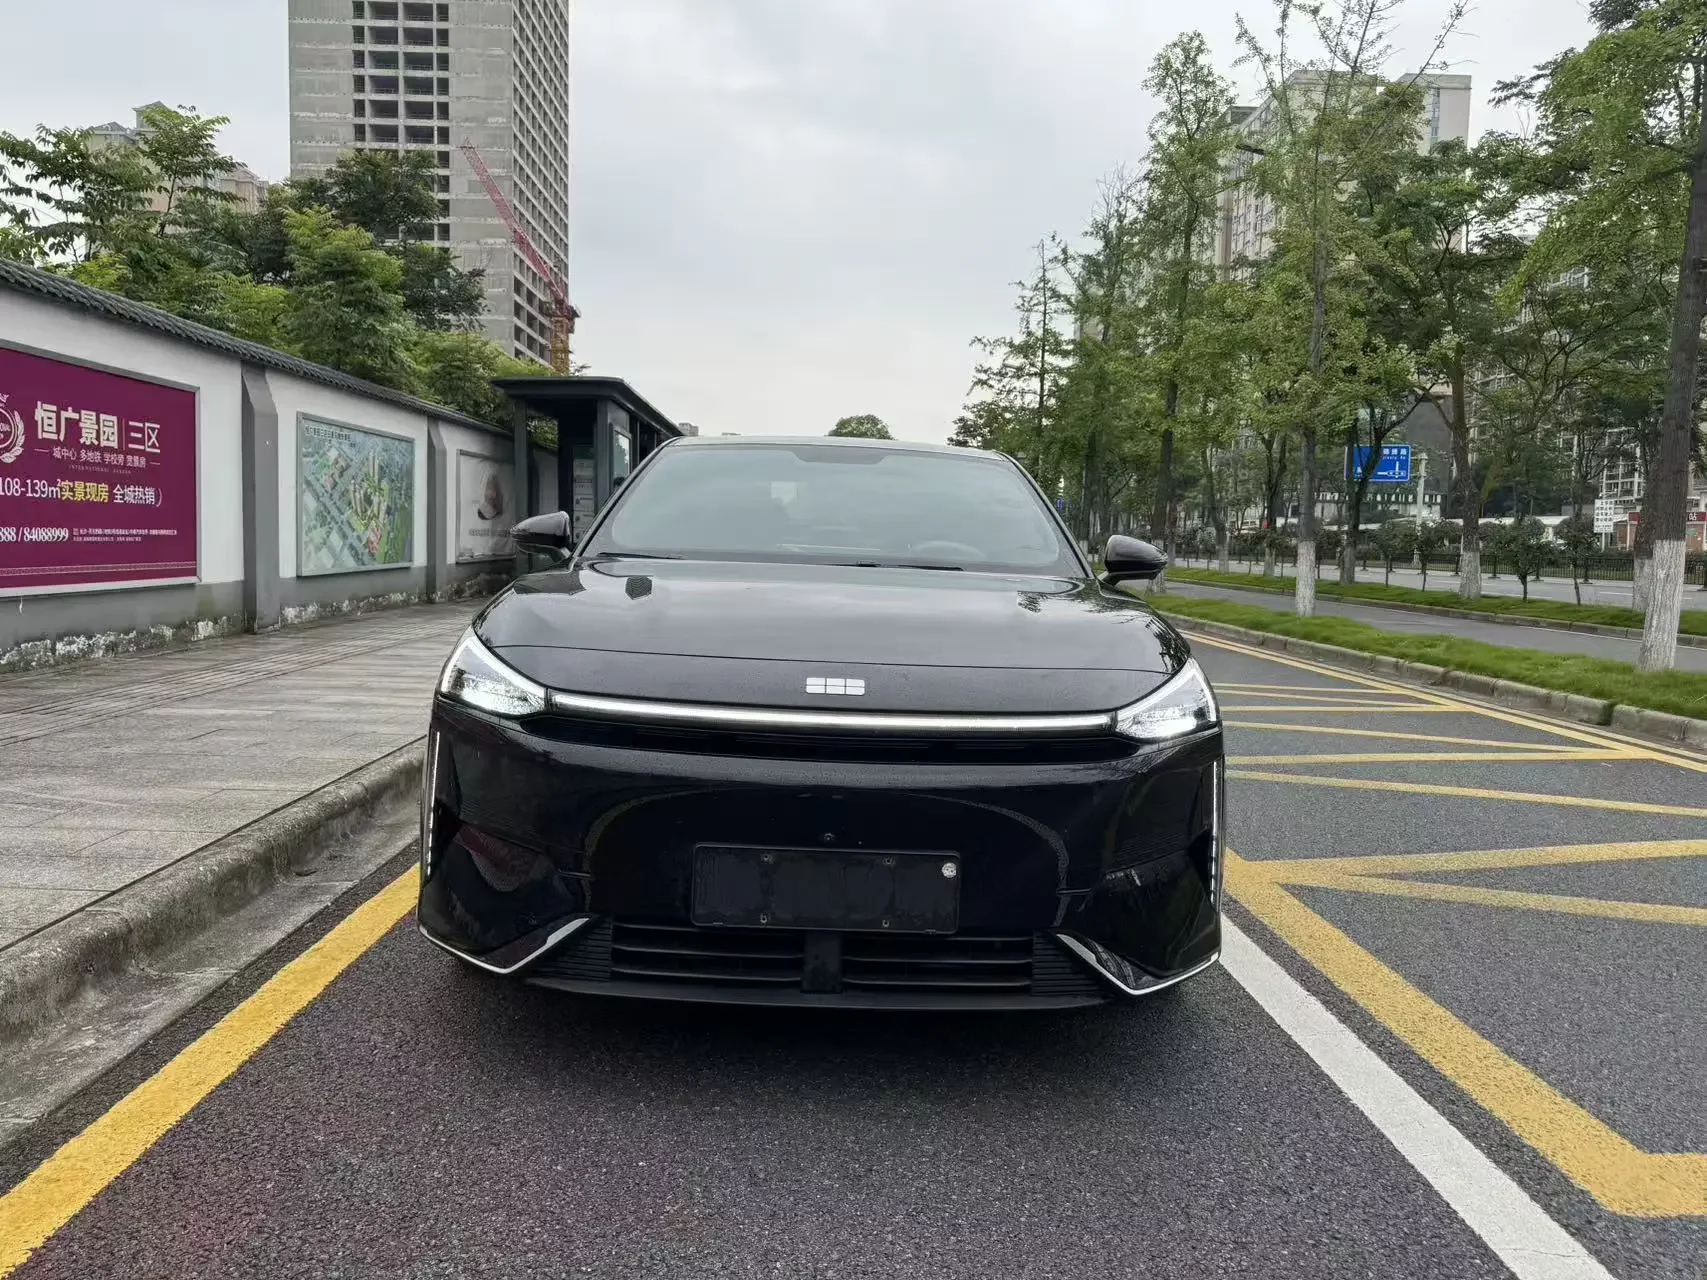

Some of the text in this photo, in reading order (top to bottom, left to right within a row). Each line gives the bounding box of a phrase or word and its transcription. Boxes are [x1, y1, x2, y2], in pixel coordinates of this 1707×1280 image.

[35, 401, 161, 453] 恒广景园 三区
